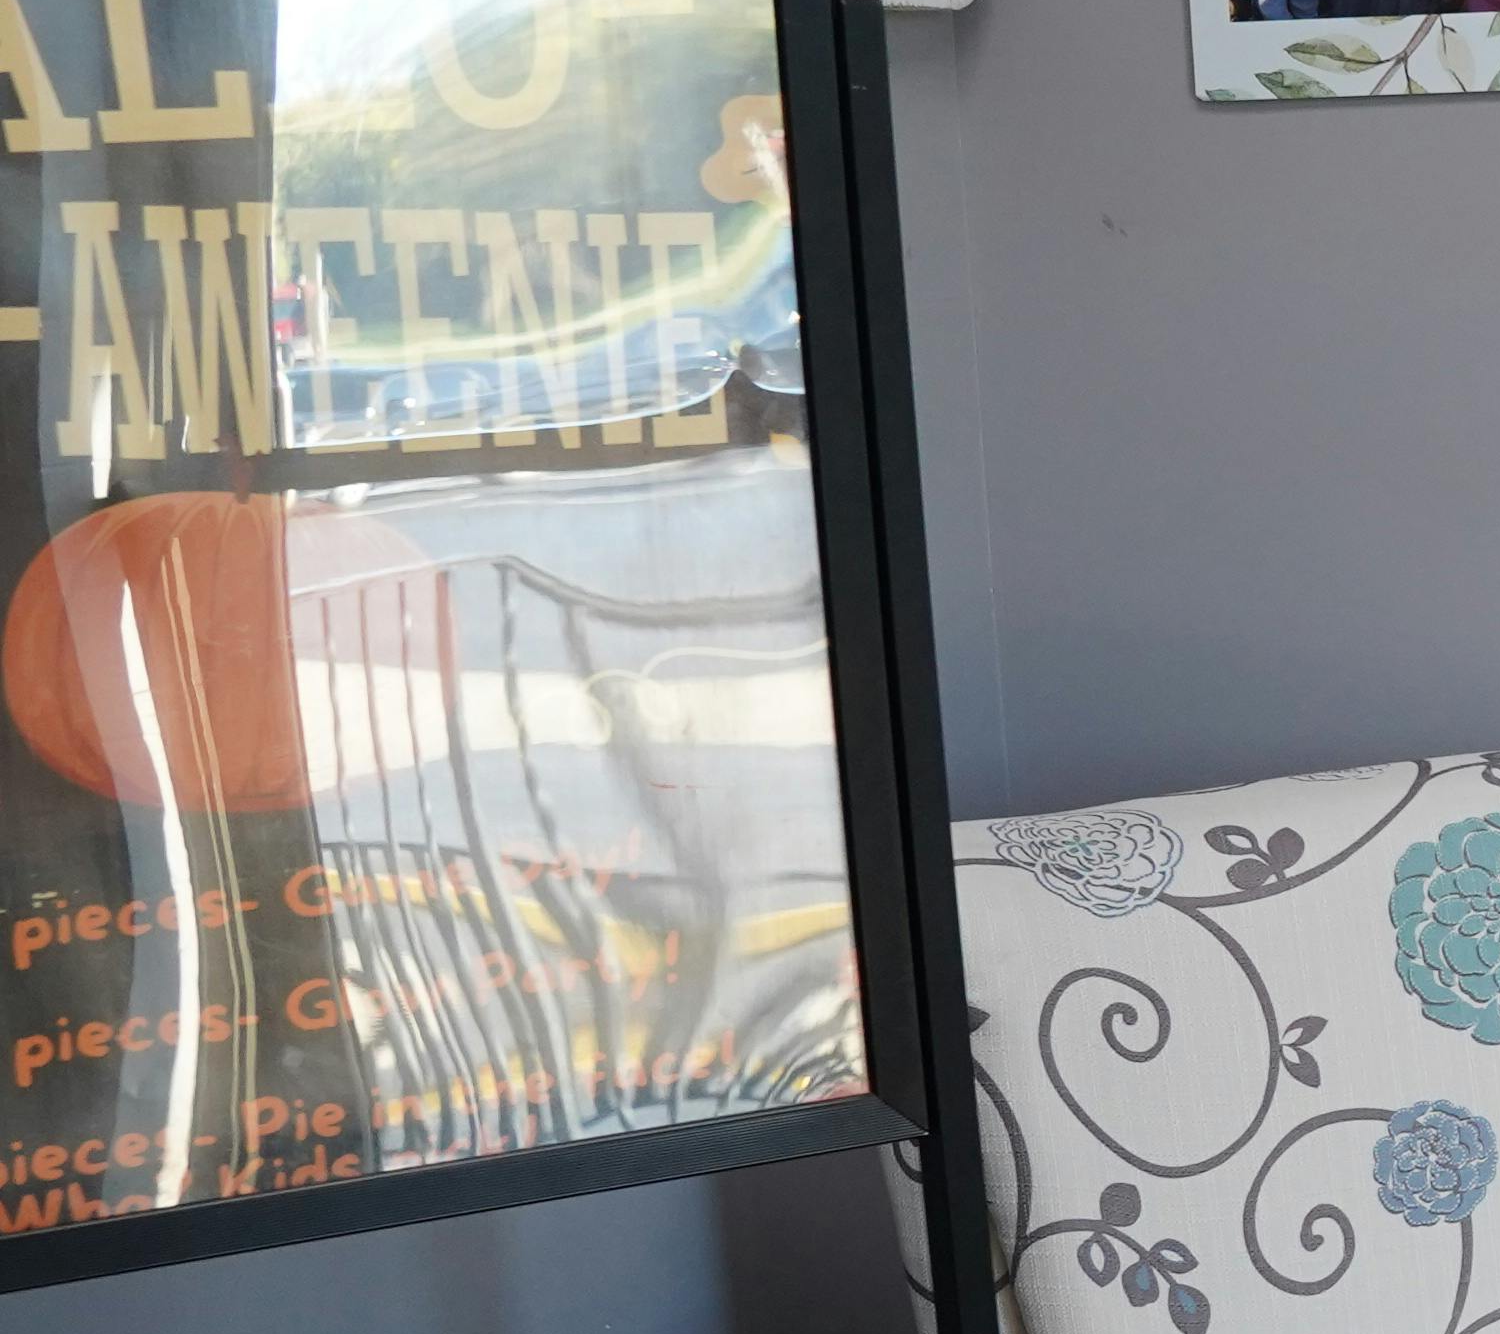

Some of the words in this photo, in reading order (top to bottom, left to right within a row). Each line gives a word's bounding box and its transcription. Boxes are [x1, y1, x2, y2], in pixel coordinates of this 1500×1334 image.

[12, 889, 258, 970] pieces-
[14, 1001, 258, 1089] pieces-
[242, 1094, 347, 1142] Pie
